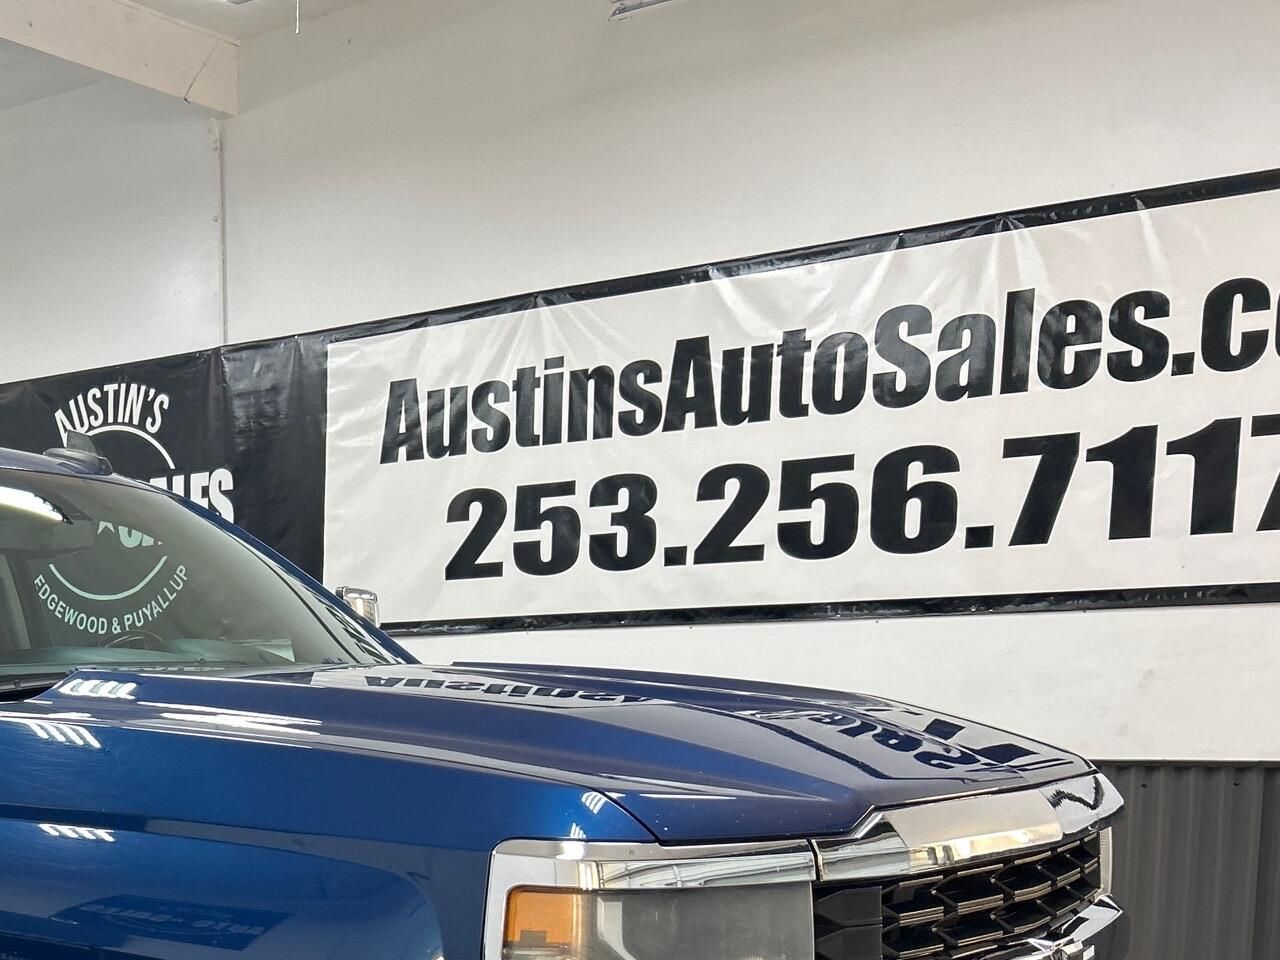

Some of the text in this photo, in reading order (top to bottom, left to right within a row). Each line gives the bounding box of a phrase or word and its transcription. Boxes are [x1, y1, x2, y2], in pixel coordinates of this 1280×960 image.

[380, 277, 1280, 465] AustinsAutoSales.c
[34, 564, 189, 635] EDGEWOOD & PUYALLUP
